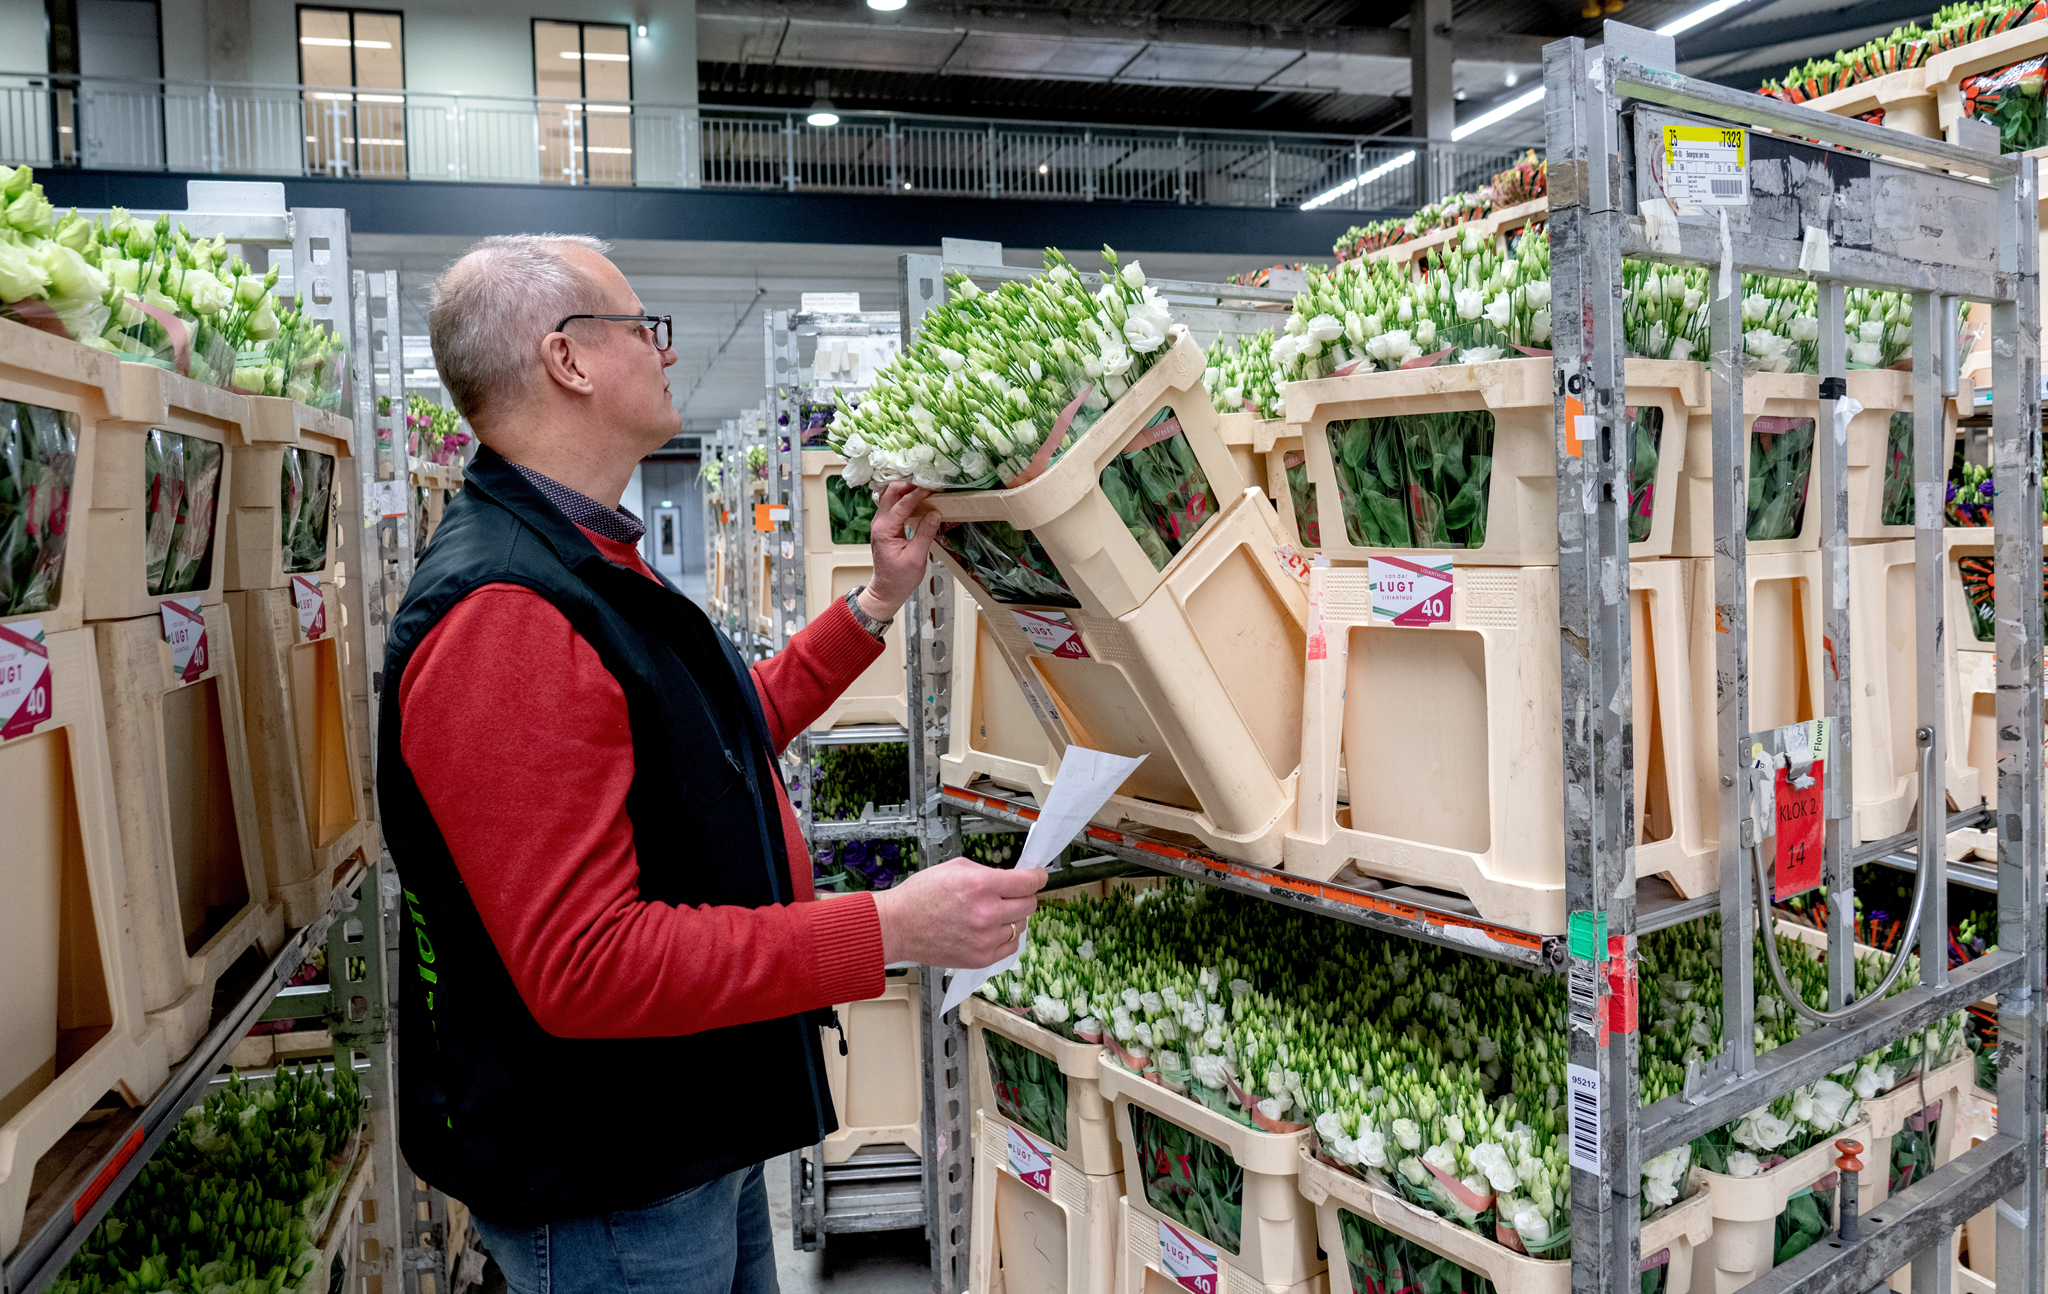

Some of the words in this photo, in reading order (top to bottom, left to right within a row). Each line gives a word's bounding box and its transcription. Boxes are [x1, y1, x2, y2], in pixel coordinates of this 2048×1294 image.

[1721, 131, 1741, 148] 7323
[1153, 424, 1175, 438] WHEN
[1753, 421, 1773, 430] ATTERS
[1158, 493, 1206, 539] UG
[1420, 568, 1447, 580] LISIANTHUS
[1379, 581, 1414, 592] LUGT
[1421, 599, 1444, 617] 40
[171, 629, 189, 645] LUGT
[1027, 626, 1053, 636] LUGT
[194, 646, 204, 666] 40
[1065, 641, 1082, 654] 40
[0, 664, 22, 685] UGT
[26, 686, 46, 716] 40
[1813, 719, 1824, 752] Flower
[1780, 800, 1807, 822] KLOK
[1810, 798, 1816, 815] 2
[1787, 842, 1806, 869] 14
[1572, 1075, 1597, 1090] 95212
[996, 1082, 1020, 1108] GT
[1013, 1145, 1031, 1162] LUGT
[1033, 1171, 1046, 1187] 40
[1166, 1243, 1189, 1265] LUGT
[1194, 1275, 1211, 1294] 40
